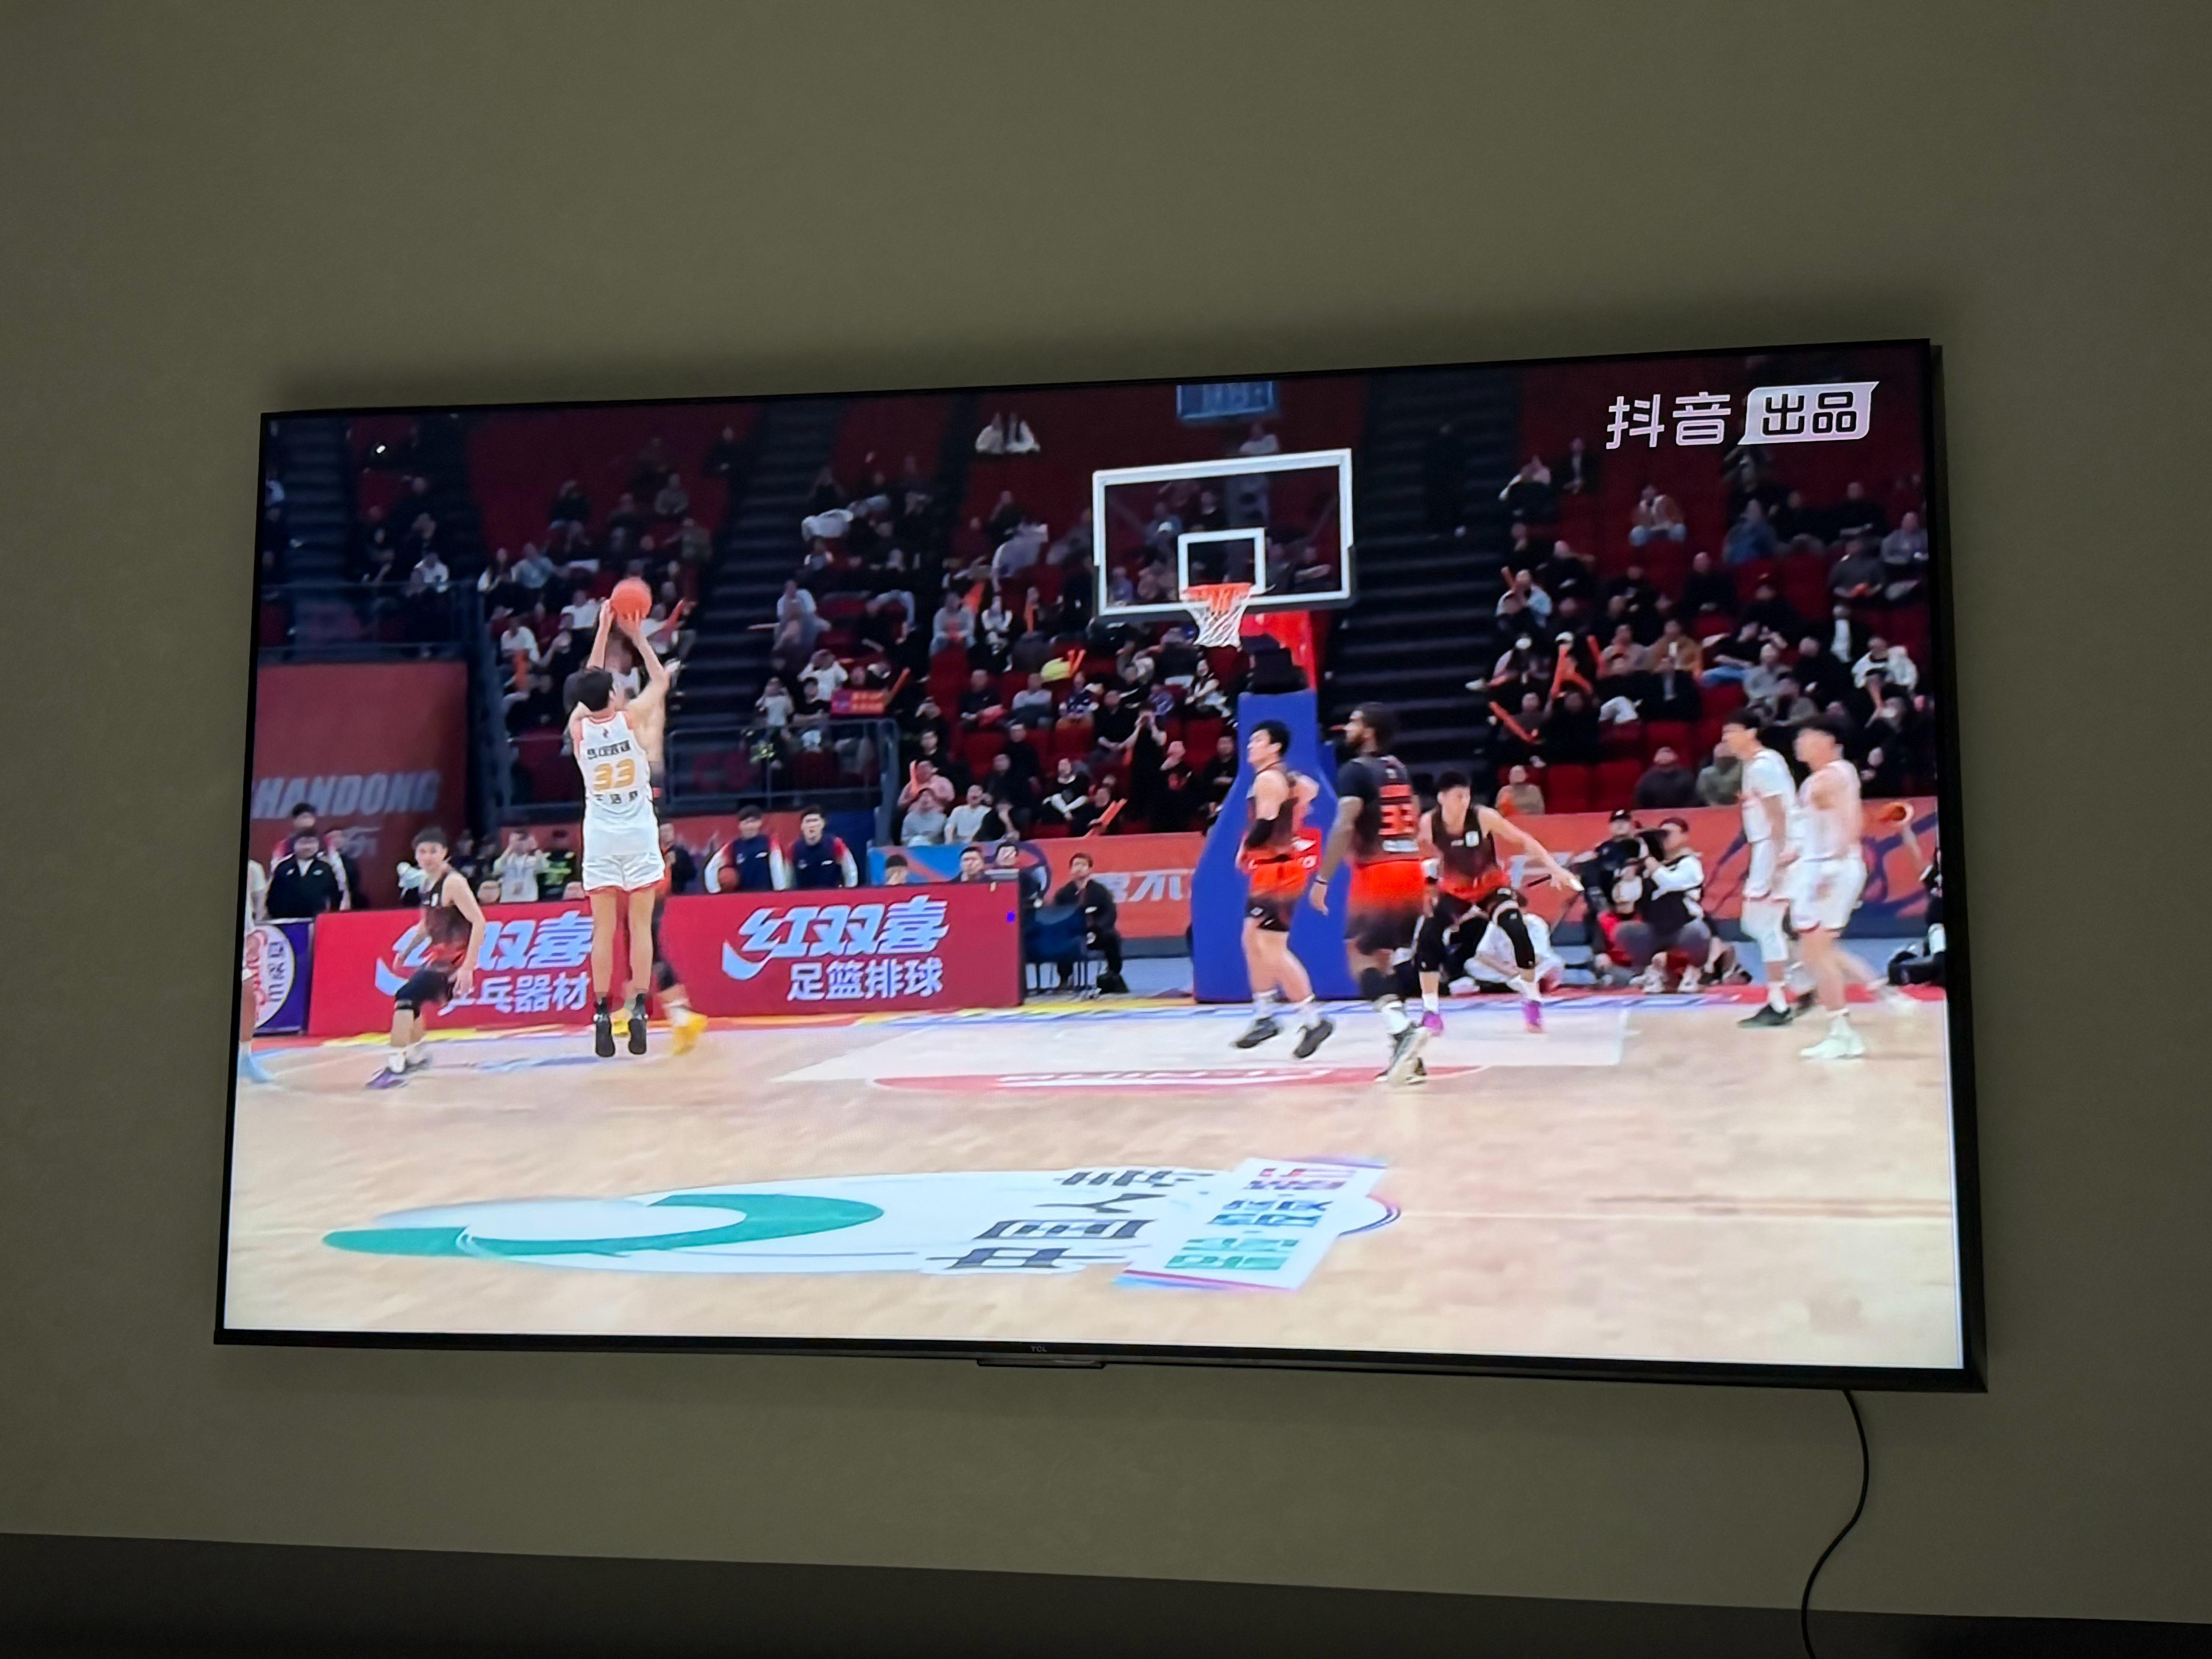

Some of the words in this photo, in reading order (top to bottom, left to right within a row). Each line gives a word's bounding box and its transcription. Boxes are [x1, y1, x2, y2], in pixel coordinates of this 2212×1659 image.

[1606, 392, 1731, 449] 抖音
[1762, 391, 1857, 436] 出品
[252, 770, 441, 819] HANDONG
[592, 759, 635, 791] 33
[737, 894, 950, 958] 红双喜
[787, 958, 943, 1001] 足篮排球
